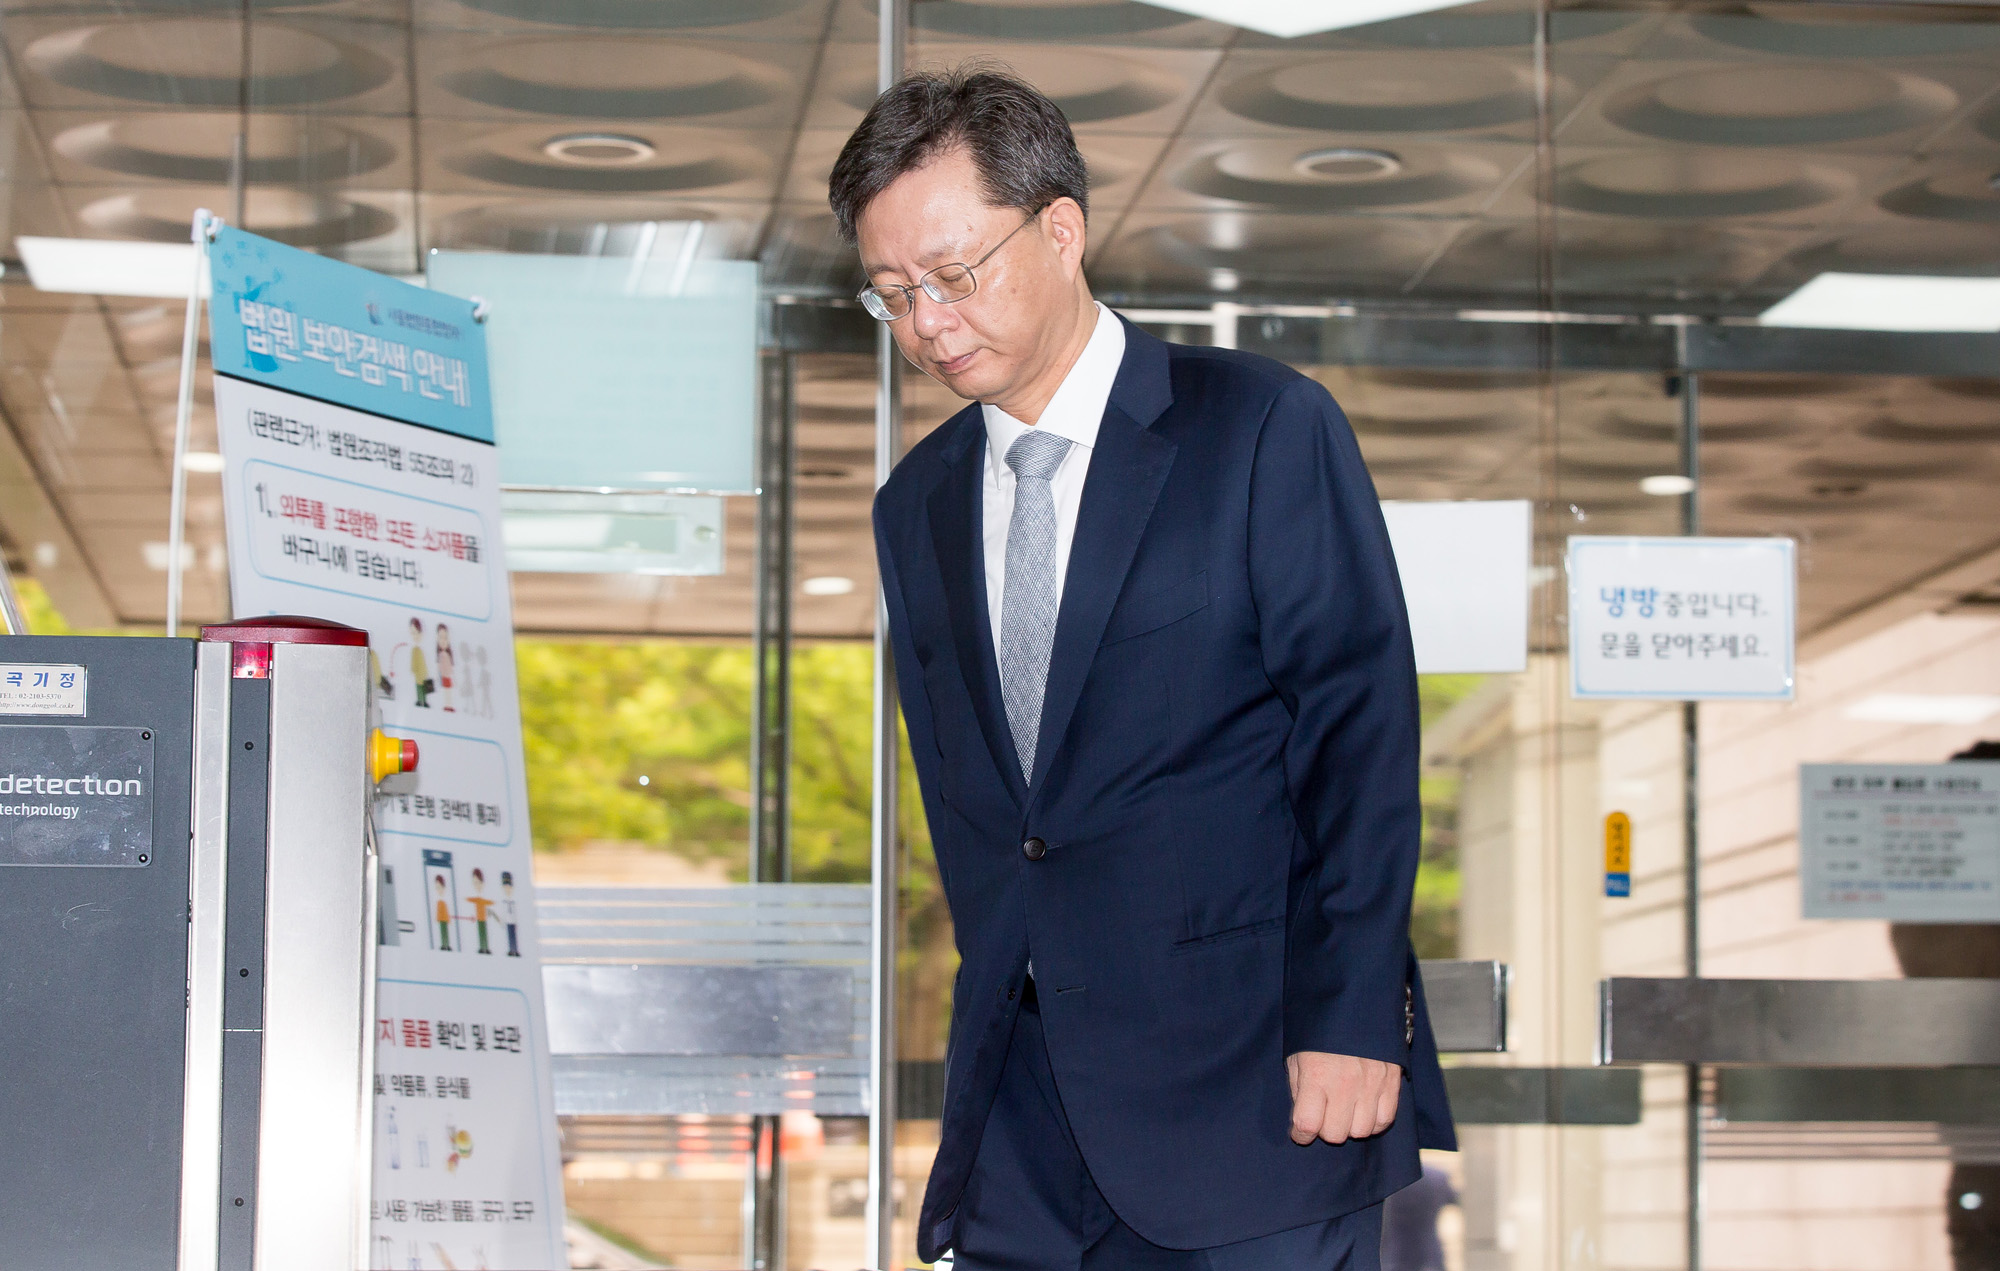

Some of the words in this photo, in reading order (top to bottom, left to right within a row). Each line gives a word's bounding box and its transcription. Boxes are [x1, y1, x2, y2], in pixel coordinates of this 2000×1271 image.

[239, 298, 301, 362] 법원
[303, 317, 414, 393] 보안검색
[412, 349, 471, 407] 안내
[248, 408, 321, 450] (관련근거:
[327, 429, 402, 471] 법원조직법
[280, 494, 326, 530] 외투를
[334, 507, 379, 541] 포함한
[385, 519, 416, 549] 모든
[282, 534, 348, 572] 바구니에
[1601, 632, 1642, 659] 문을
[0, 774, 141, 796] detection
[0, 803, 79, 820] technology
[402, 1019, 432, 1048] 물품
[437, 1020, 466, 1050] 확인
[471, 1023, 487, 1051] 및
[493, 1025, 521, 1053] 보관
